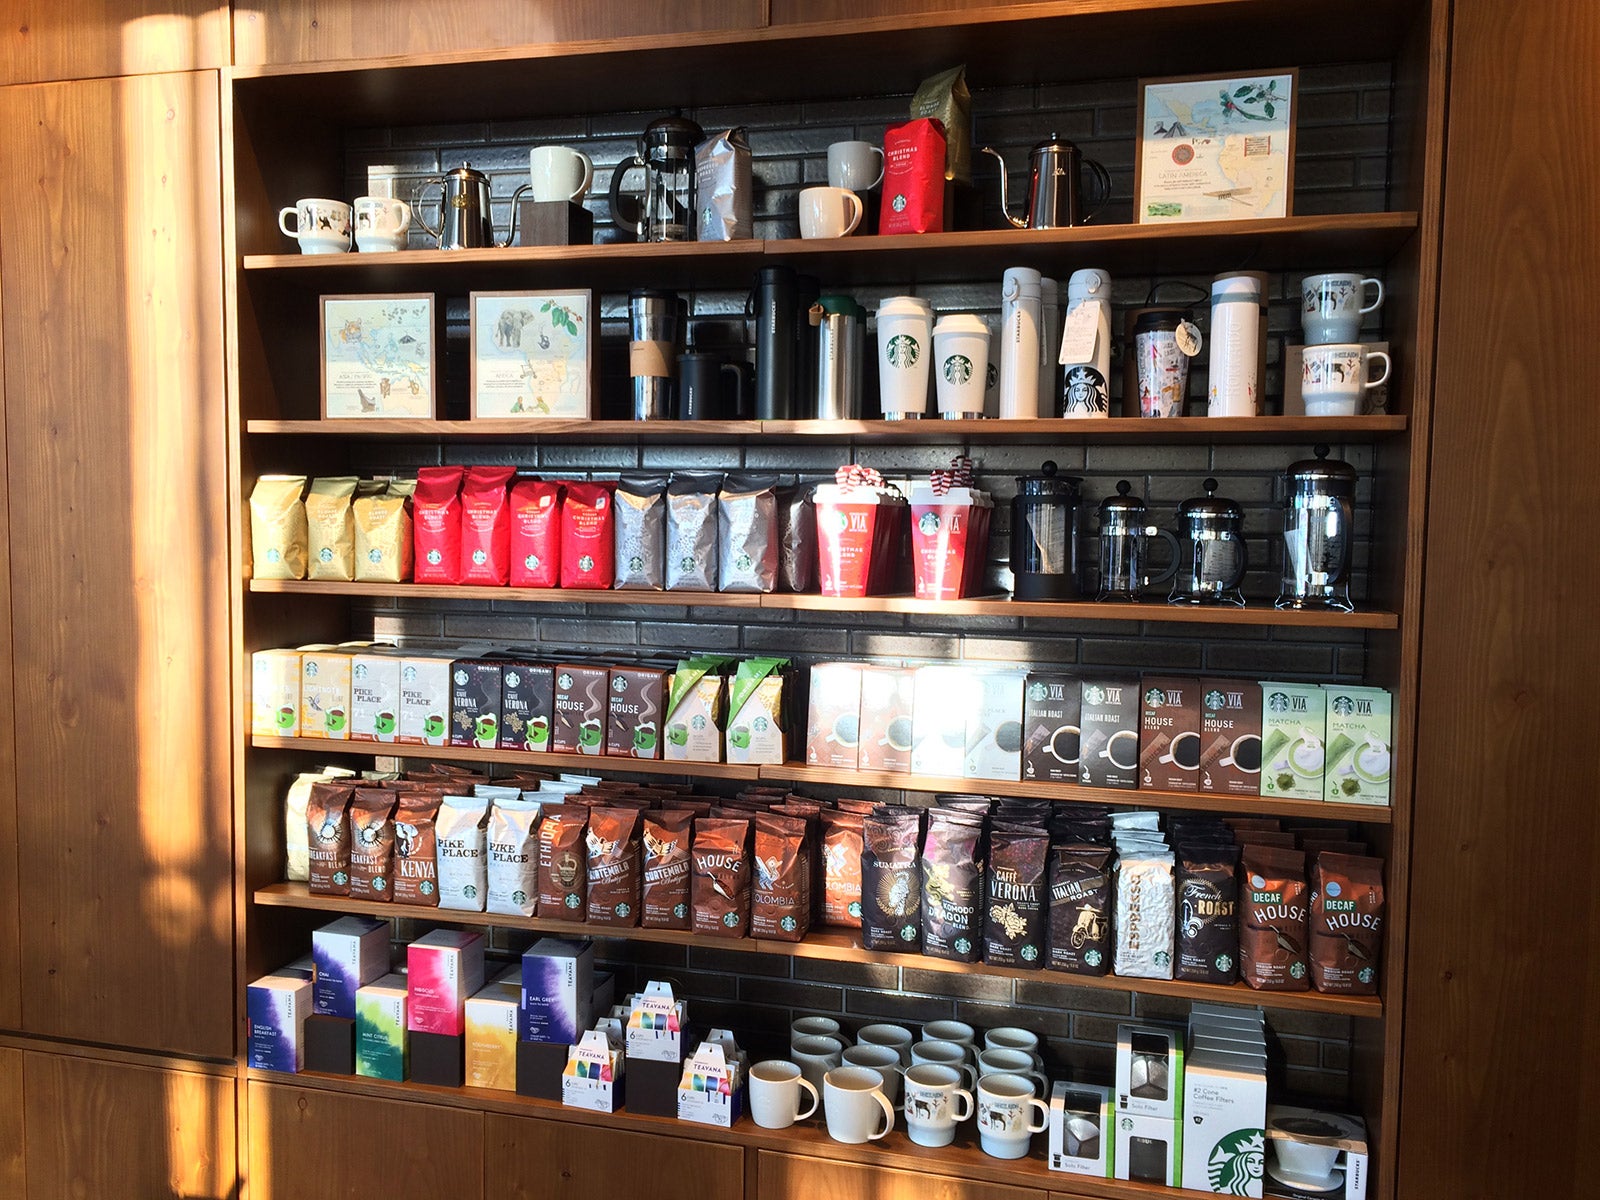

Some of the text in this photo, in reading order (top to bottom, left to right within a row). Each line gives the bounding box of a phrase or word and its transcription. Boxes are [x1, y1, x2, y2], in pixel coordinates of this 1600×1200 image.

[888, 146, 918, 157] CHRISTMAS
[893, 154, 911, 162] BLEND
[1158, 170, 1209, 180] LATIN AMERICA
[851, 515, 866, 529] VIA
[354, 688, 373, 696] PIKE
[403, 690, 422, 698] PIKE
[1050, 686, 1063, 698] VIA
[1107, 690, 1121, 702] VIA
[1168, 691, 1181, 704] VIA
[406, 698, 431, 706] PLACE
[454, 697, 477, 708] VERONA
[505, 699, 527, 710] VERONA
[556, 700, 584, 711] HOUSE
[1228, 694, 1242, 707] VIA
[1293, 698, 1307, 710] VIA
[611, 703, 639, 714] HOUSE
[1357, 701, 1372, 714] VIA
[1028, 710, 1063, 719] ITALIAN ROAST
[1085, 714, 1120, 723] ITALIAN ROAST
[1145, 717, 1173, 726] HOUSE
[1204, 719, 1234, 729] HOUSE
[1268, 718, 1301, 726] MATCHA
[1333, 722, 1367, 731] MATCHA
[438, 838, 465, 848] PIKE
[540, 814, 562, 868] ETHIOPIA
[442, 848, 479, 858] PLACE
[490, 843, 516, 854] PIKE
[493, 853, 529, 864] PLACE
[697, 854, 742, 873] HOUSE
[401, 860, 436, 878] KENYA
[873, 861, 917, 869] SUMATRA
[589, 862, 630, 880] GUATEMALA
[645, 862, 690, 882] GUATEMALA
[996, 870, 1017, 883] CAFFÈ
[991, 880, 1037, 902] VERONA
[1052, 881, 1082, 900] ITALIAN
[1070, 888, 1099, 902] ROAST
[1184, 884, 1222, 901] French
[754, 893, 795, 905] OLOMBIA
[1253, 892, 1281, 903] DECAF
[942, 901, 974, 915] KOMODO
[1198, 901, 1235, 916] ROAST
[1326, 900, 1355, 911] DECAF
[928, 906, 968, 924] DRAGON
[1129, 874, 1141, 950] ESPRESSO
[1254, 905, 1307, 924] HOUSE
[953, 922, 970, 931] BLEND
[1326, 913, 1381, 931] HOUSE
[642, 1002, 671, 1011] TEAVANA
[254, 1024, 272, 1032] ENGLISH
[254, 1029, 277, 1037] BREAKFAST
[629, 1030, 635, 1039] 6
[579, 1050, 605, 1060] TEAVANA
[693, 1064, 722, 1074] TEAVANA
[565, 1079, 571, 1088] 6
[681, 1092, 687, 1101] 6
[1193, 1094, 1234, 1104] Coffee Filters
